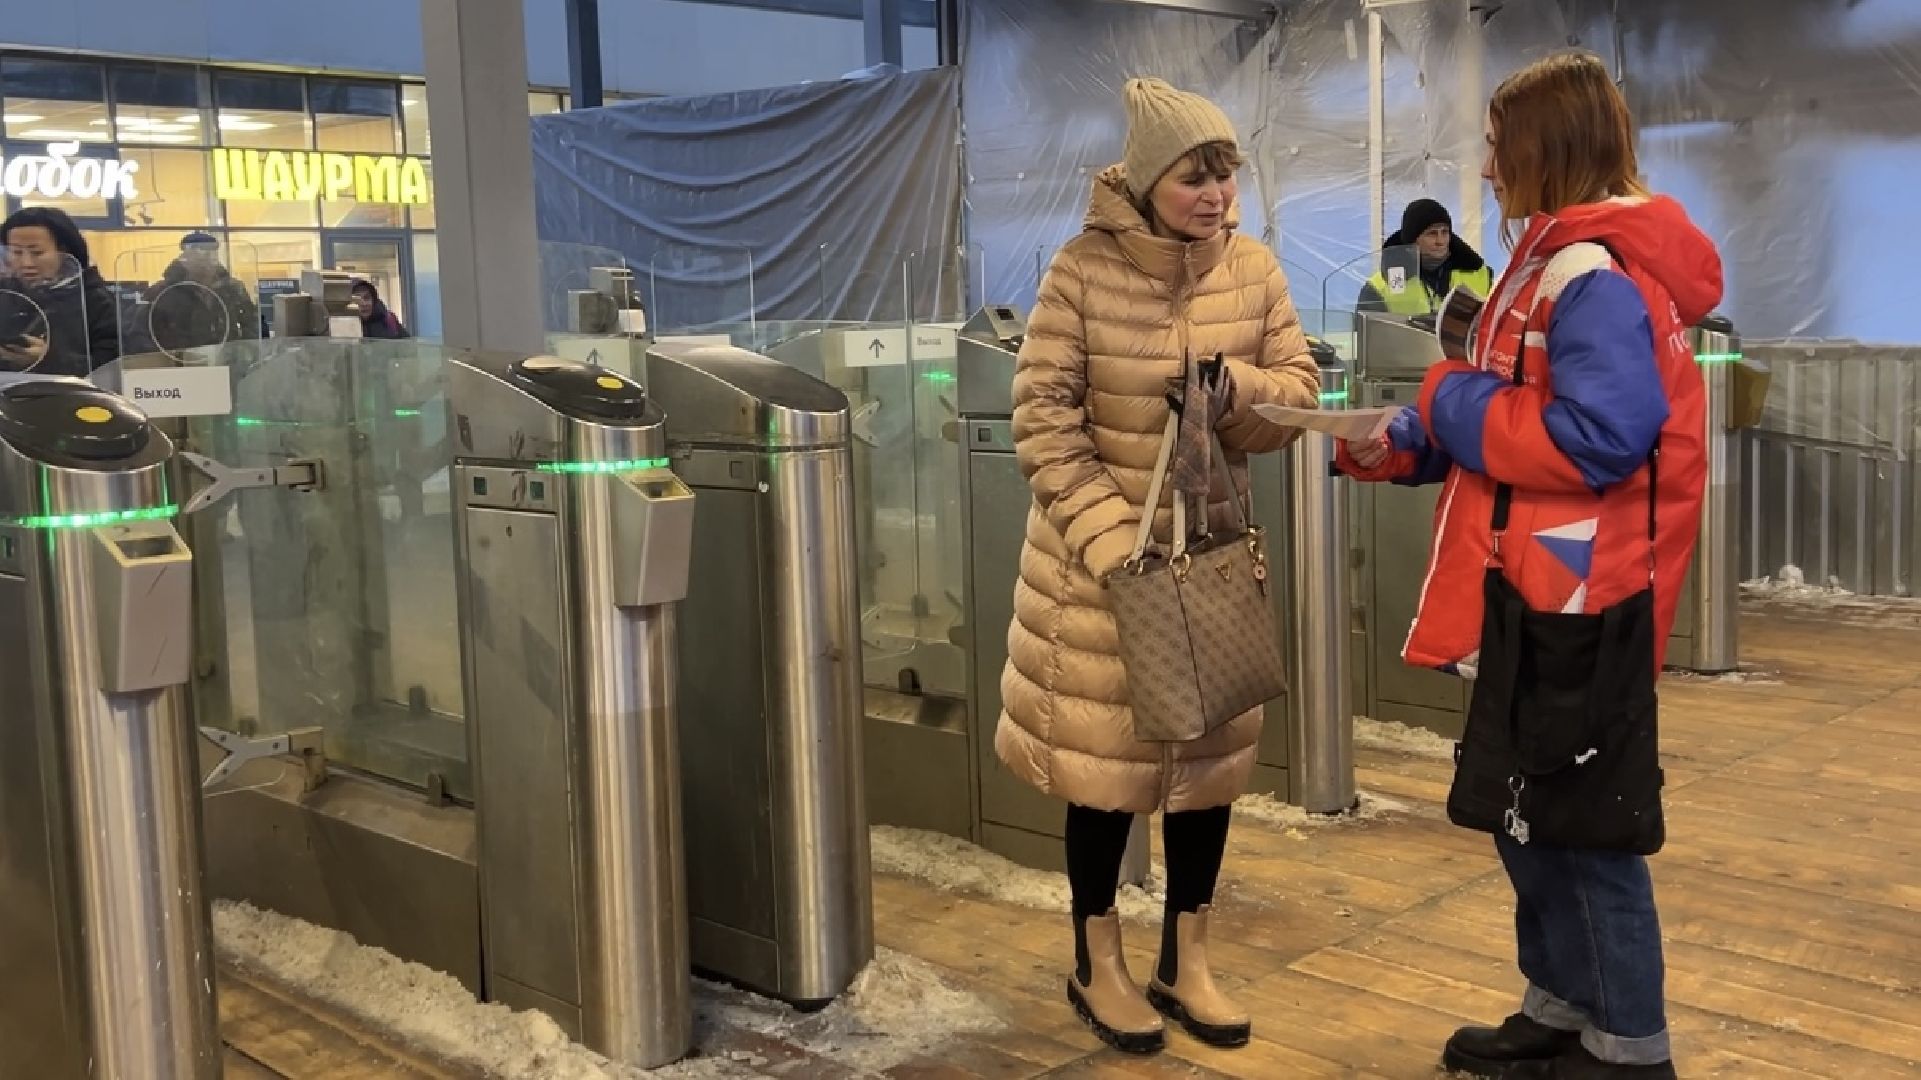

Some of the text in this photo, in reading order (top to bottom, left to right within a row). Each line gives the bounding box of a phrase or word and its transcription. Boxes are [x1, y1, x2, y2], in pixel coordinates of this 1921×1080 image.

[0, 140, 139, 199] обок
[213, 148, 428, 203] ШАУРМА
[134, 386, 182, 400] Выход
